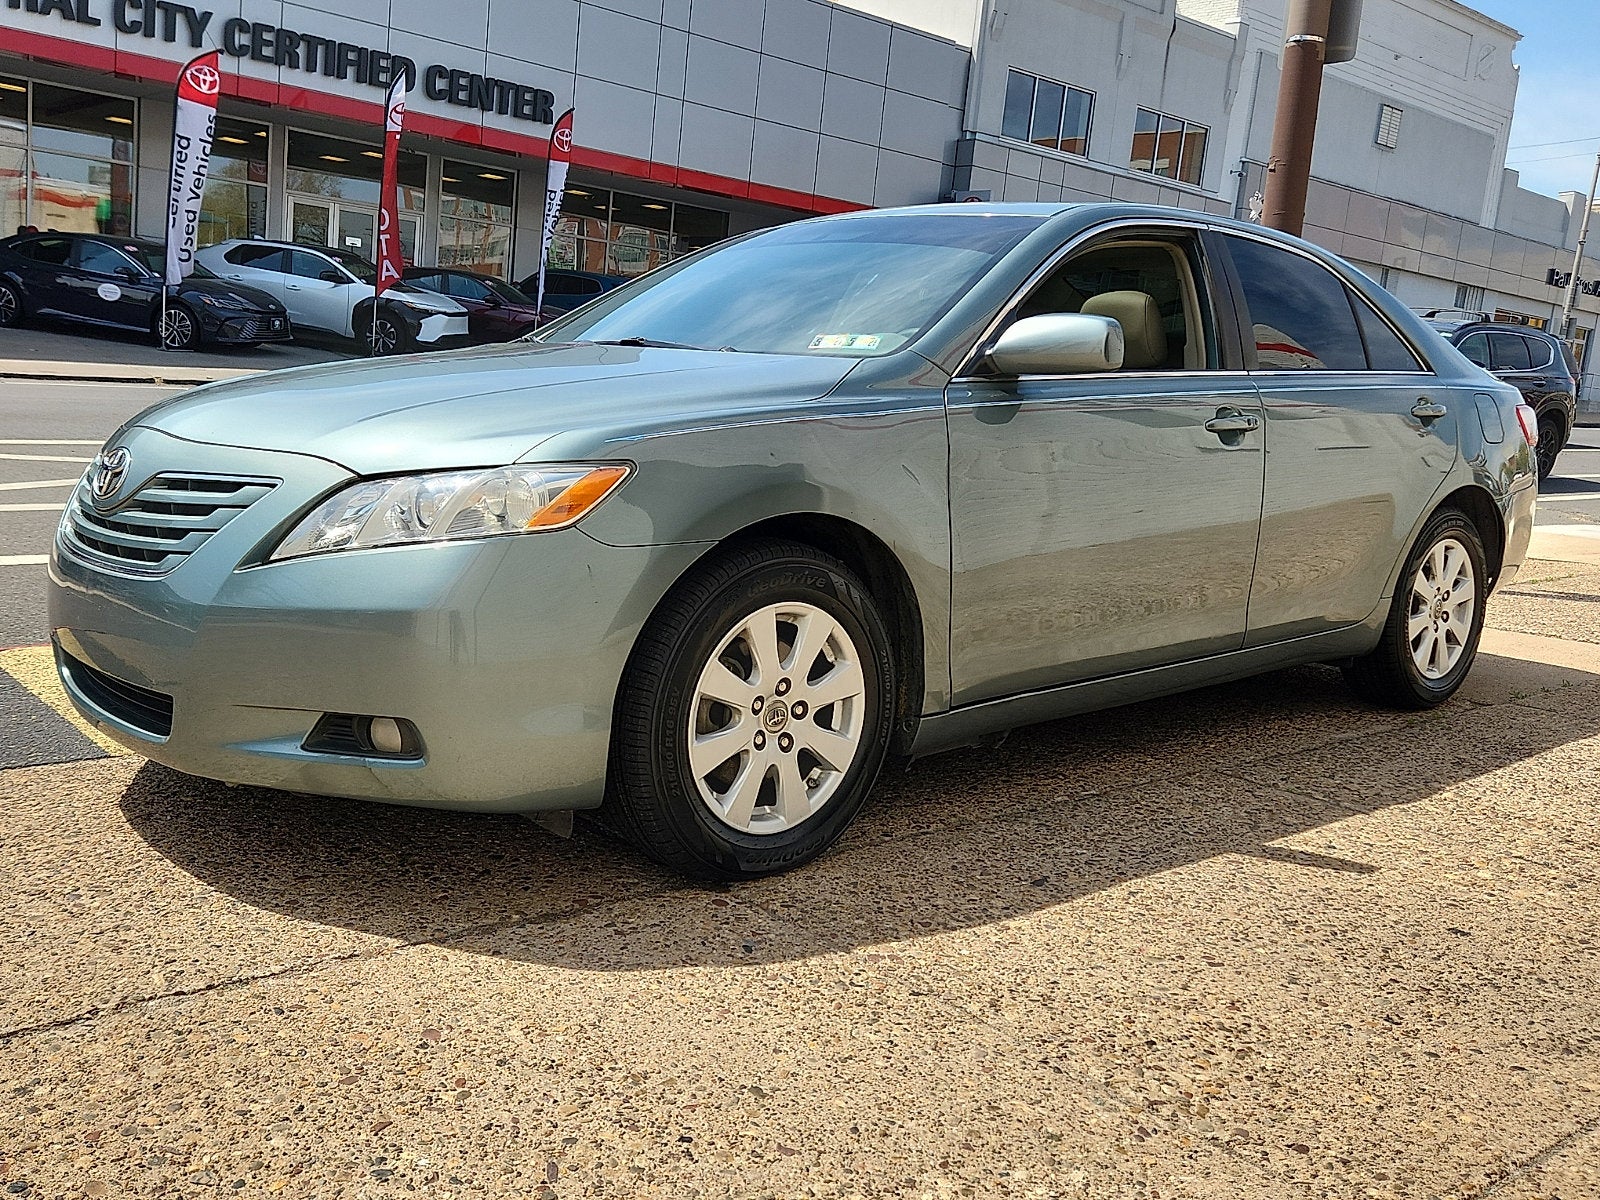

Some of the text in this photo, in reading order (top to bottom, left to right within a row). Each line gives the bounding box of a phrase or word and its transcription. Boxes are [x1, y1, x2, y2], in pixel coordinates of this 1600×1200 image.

[114, 0, 213, 48] CITY
[223, 17, 416, 92] CERTIFIED
[425, 64, 554, 125] CENTER
[178, 113, 217, 263] Used Vehicles
